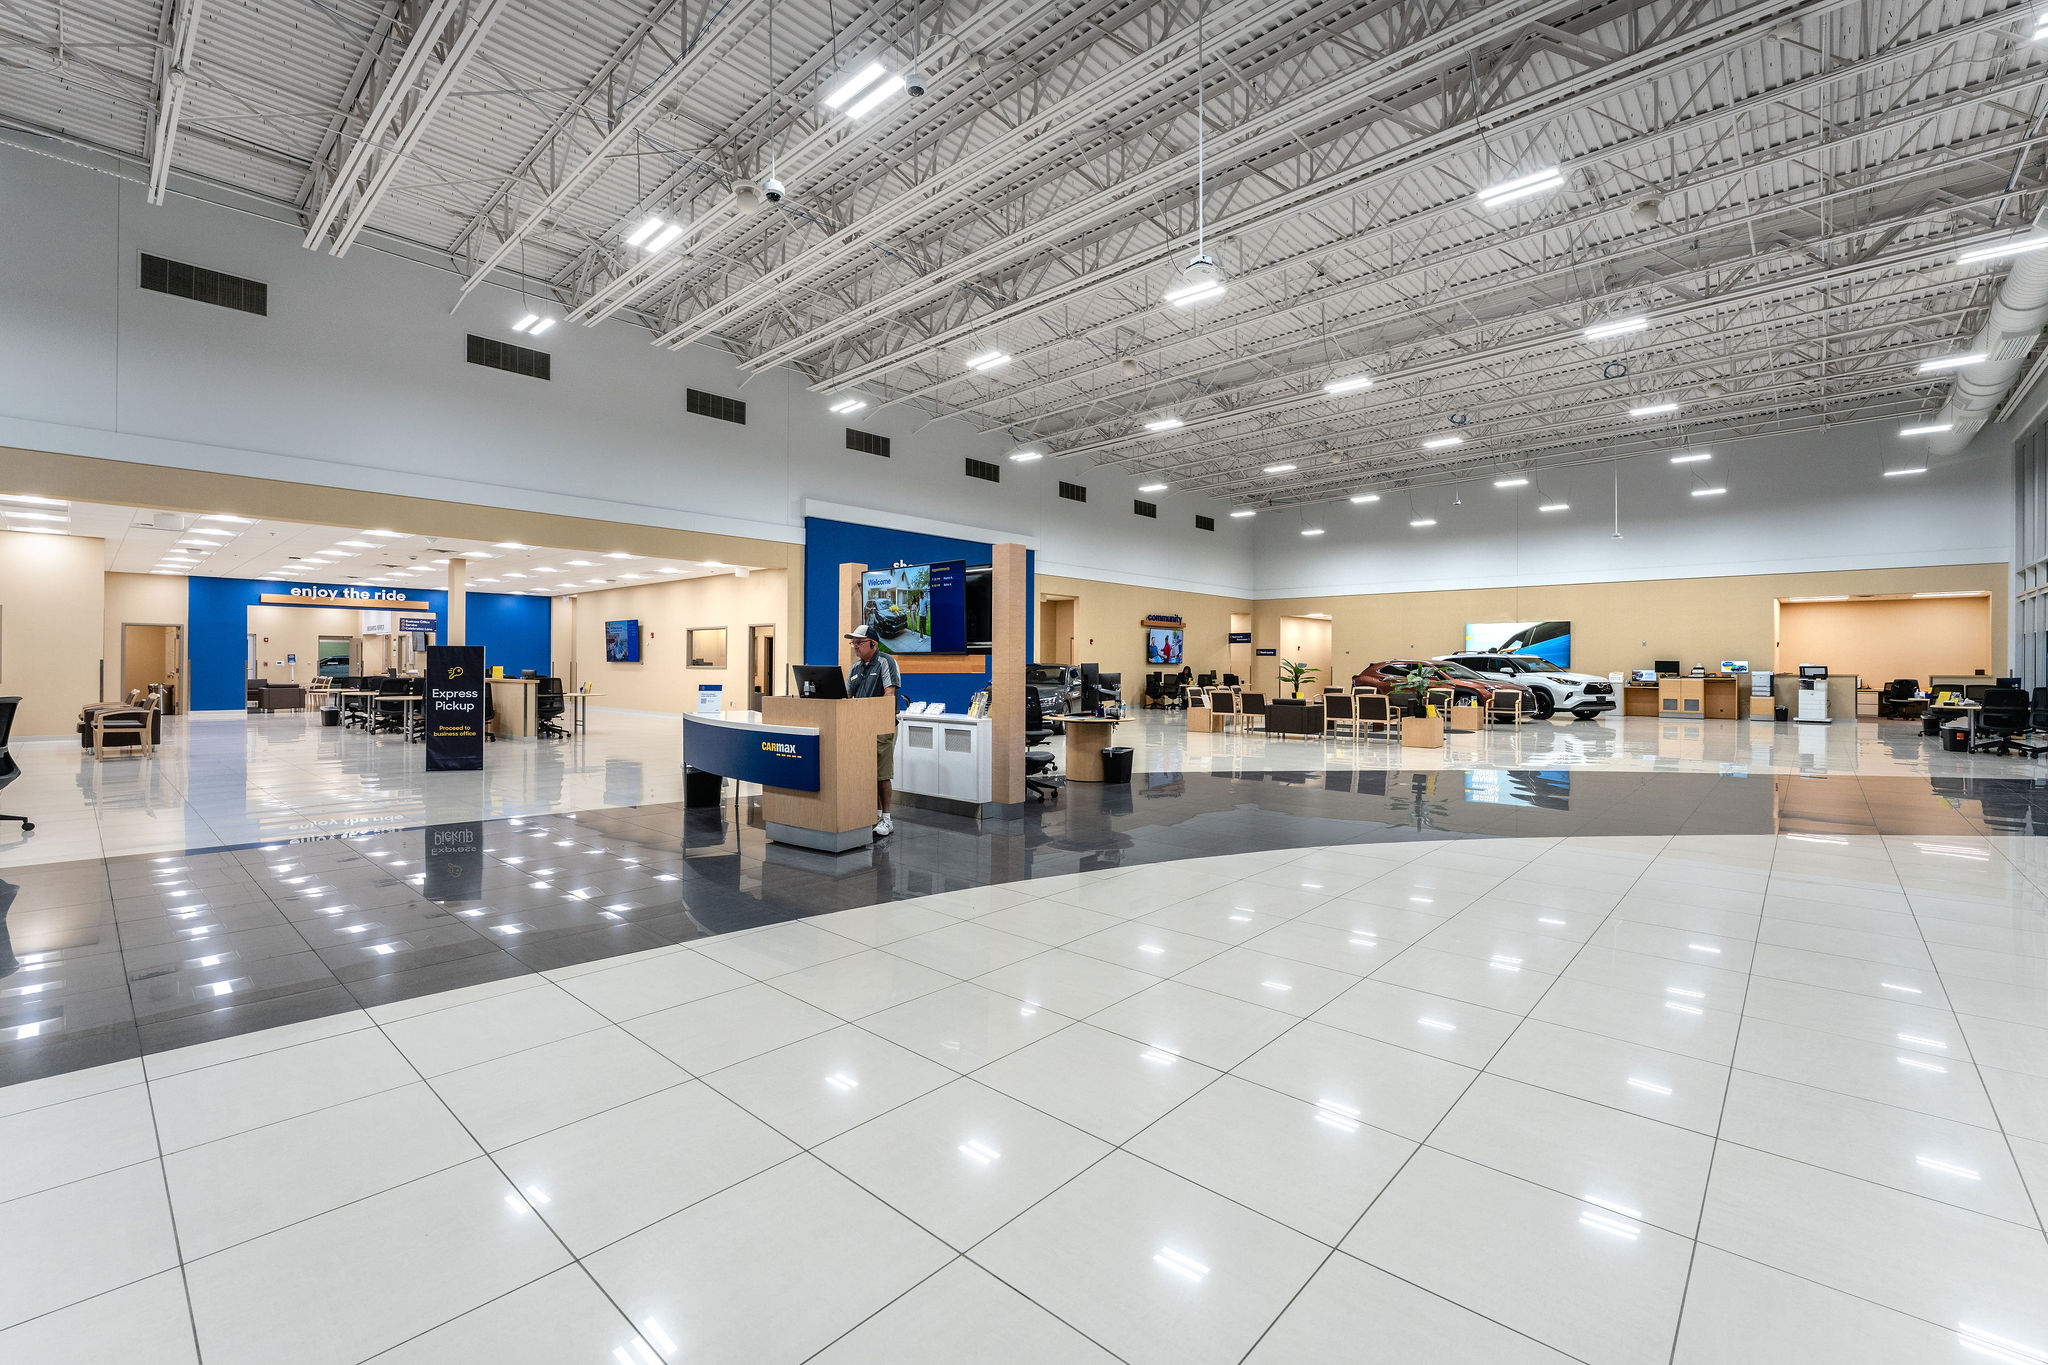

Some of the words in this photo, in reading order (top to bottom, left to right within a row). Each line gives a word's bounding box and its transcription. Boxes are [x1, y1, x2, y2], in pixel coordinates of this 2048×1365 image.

[868, 578, 891, 586] Welcome
[290, 586, 338, 601] enjoy
[343, 587, 370, 600] the
[374, 589, 407, 602] ride
[1147, 613, 1182, 625] community
[432, 688, 478, 700] Express
[435, 701, 475, 713] Pickup
[761, 741, 796, 754] CARmax
